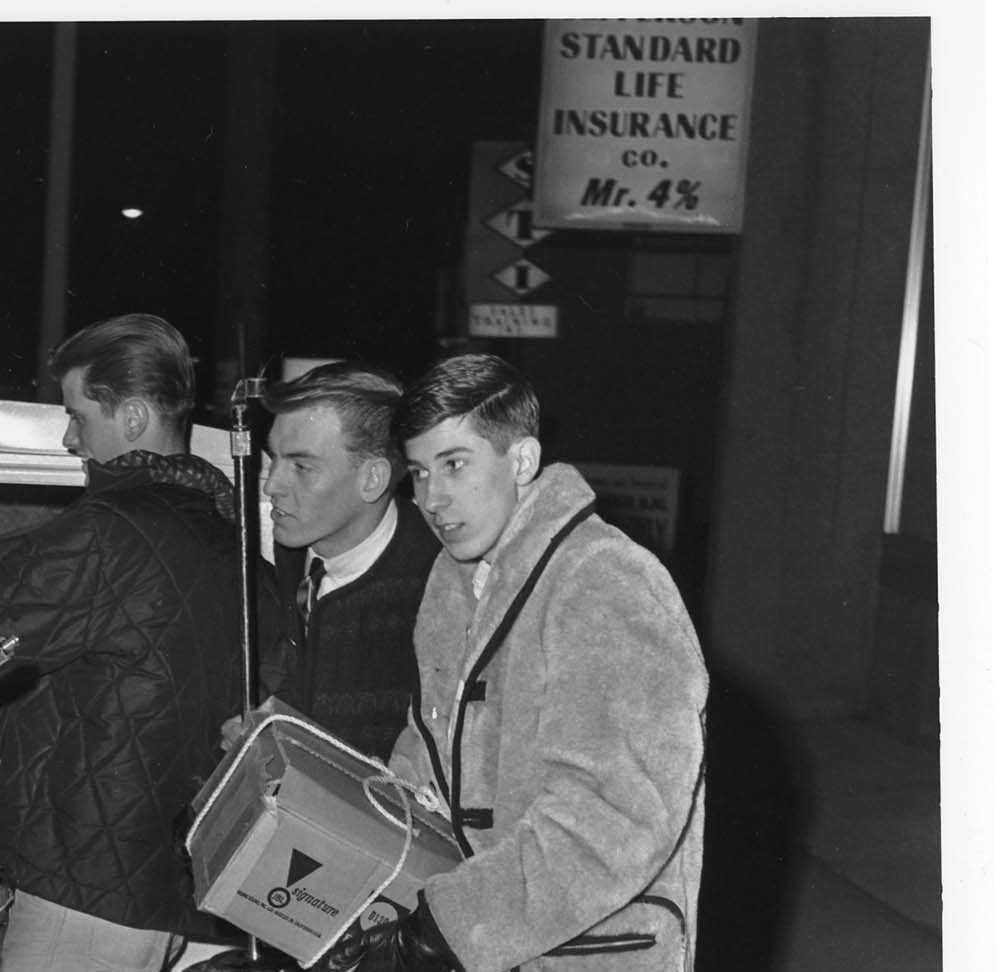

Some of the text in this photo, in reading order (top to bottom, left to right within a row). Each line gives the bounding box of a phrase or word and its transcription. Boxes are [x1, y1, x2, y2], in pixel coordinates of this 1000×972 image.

[559, 32, 742, 64] STANDARD
[614, 71, 685, 98] LIFE
[553, 109, 739, 141] INSURANCE
[580, 178, 702, 210] Mr. 4%
[292, 887, 340, 917] signature
